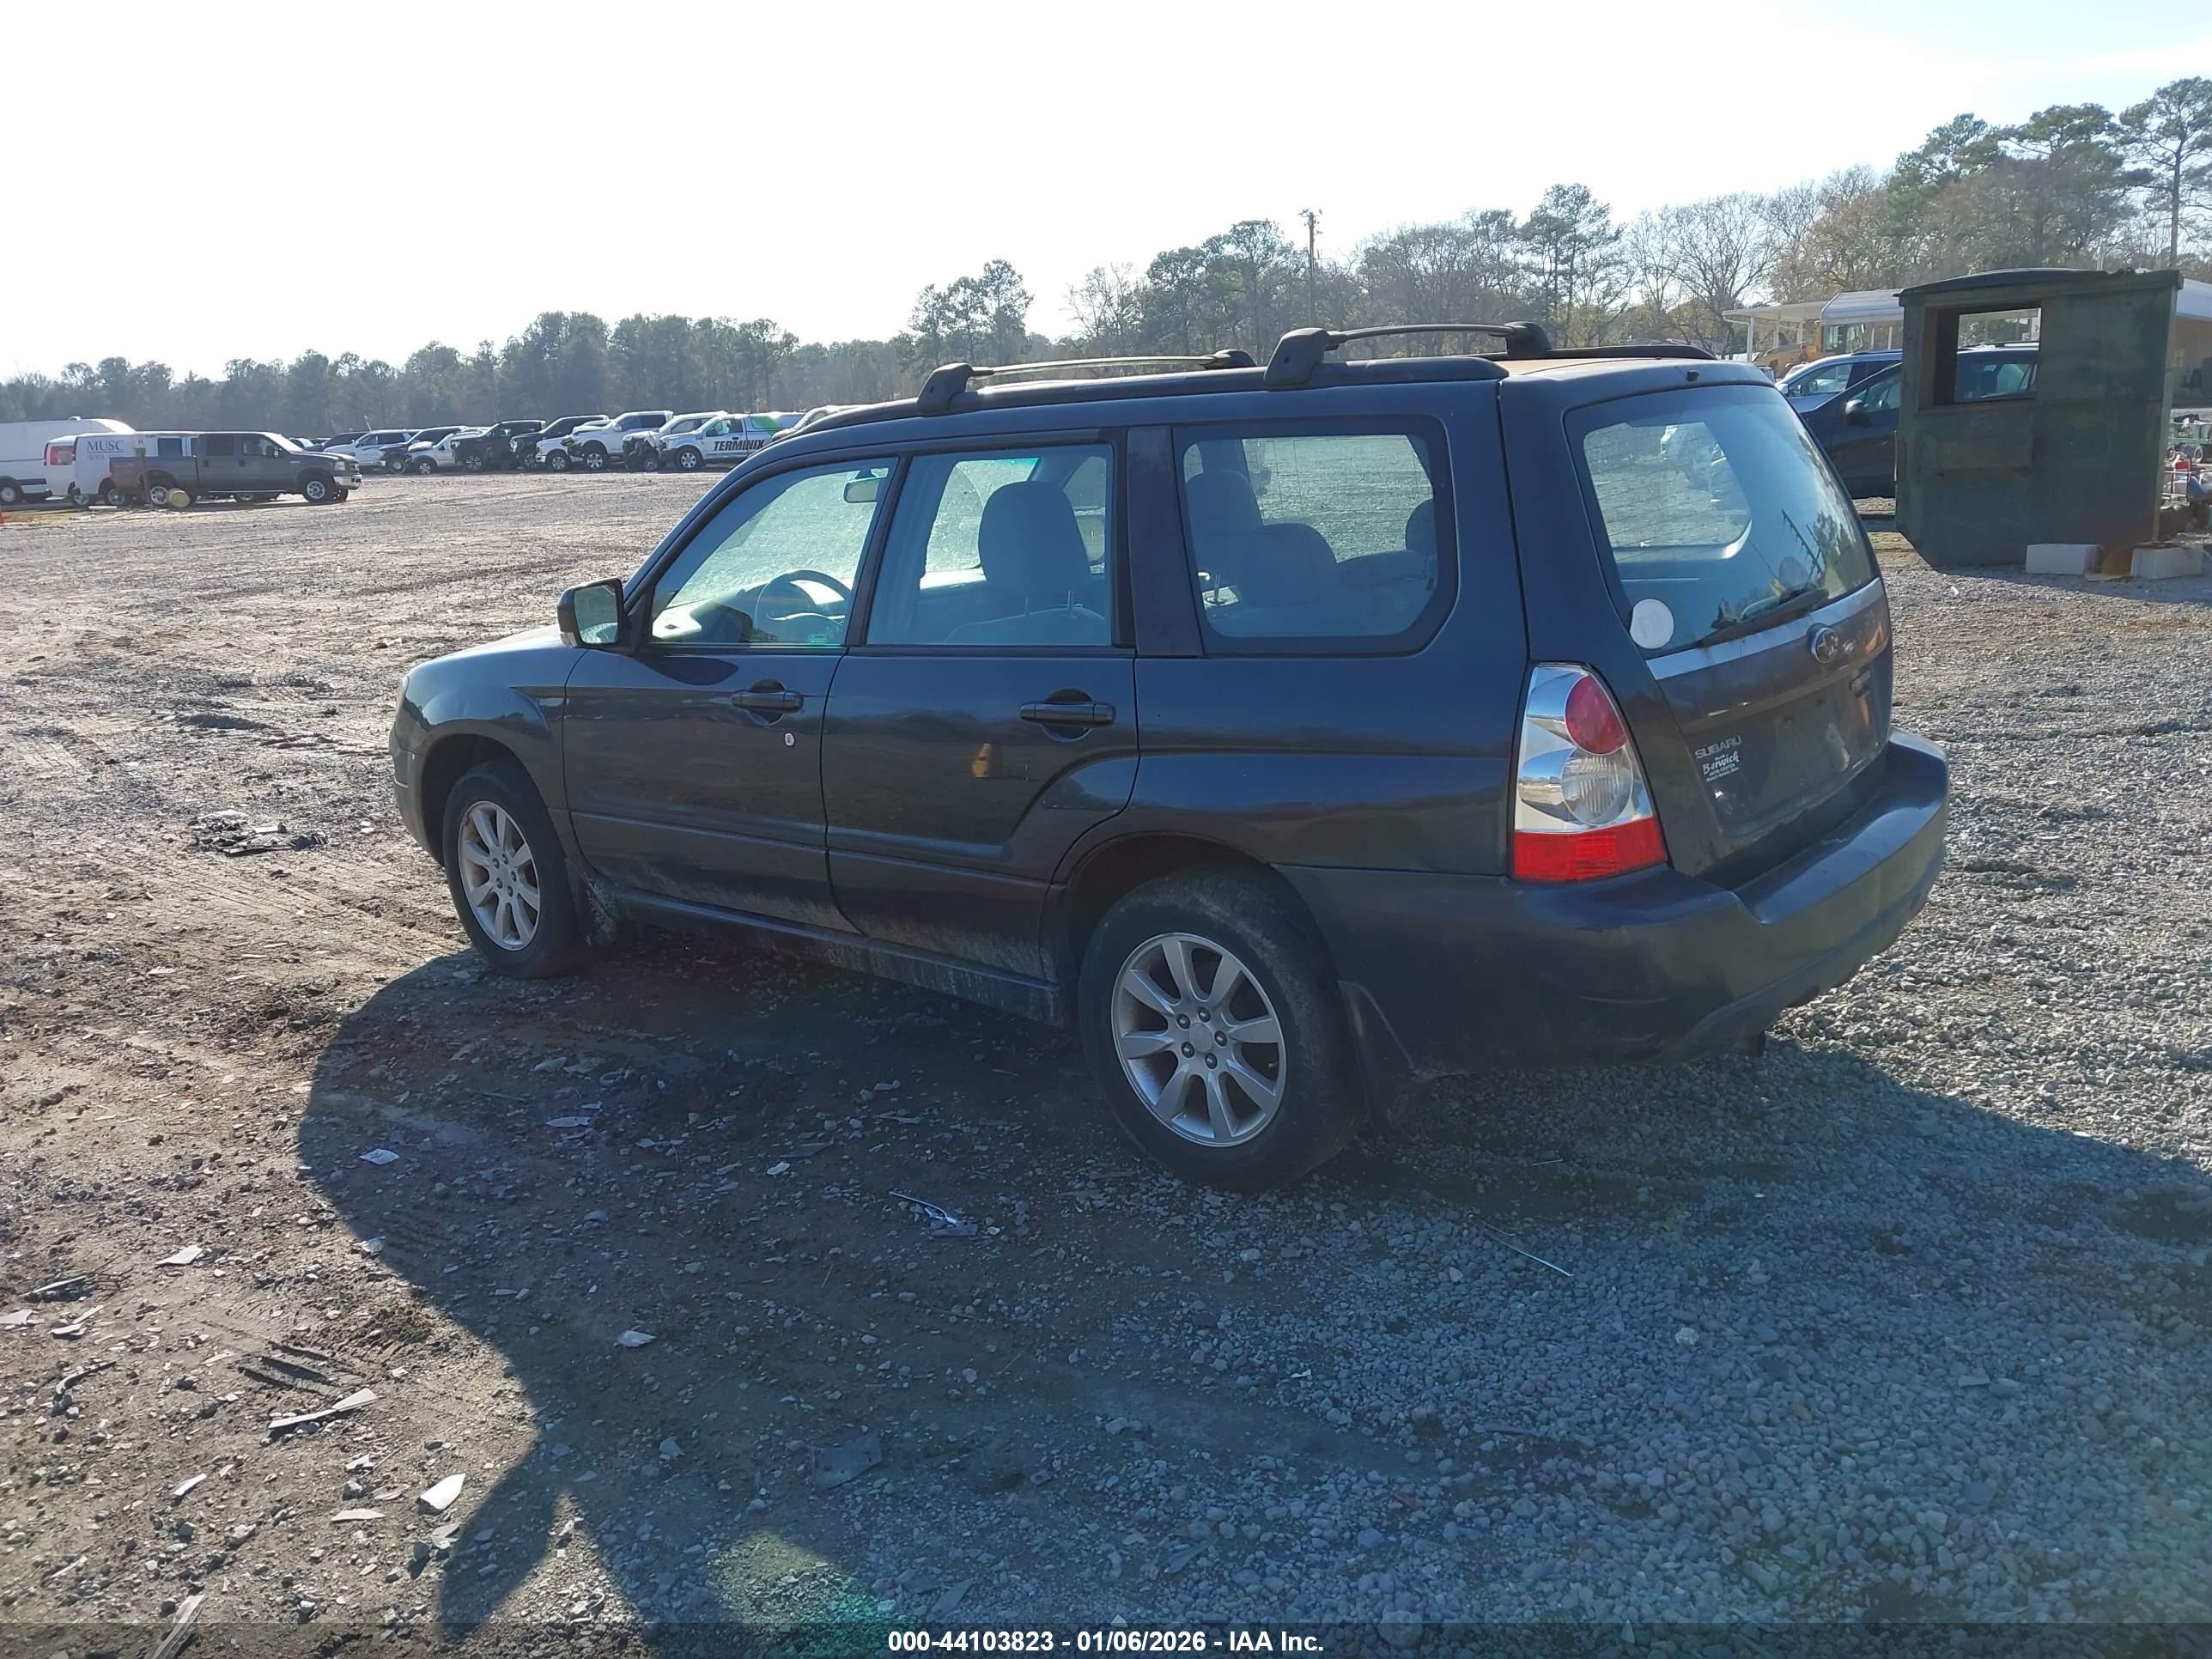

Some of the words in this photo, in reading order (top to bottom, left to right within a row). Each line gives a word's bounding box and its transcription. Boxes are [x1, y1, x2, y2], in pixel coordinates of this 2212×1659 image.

[87, 440, 124, 451] MUSC
[714, 439, 765, 451] TERMINIX
[1694, 735, 1741, 759] SUBARU
